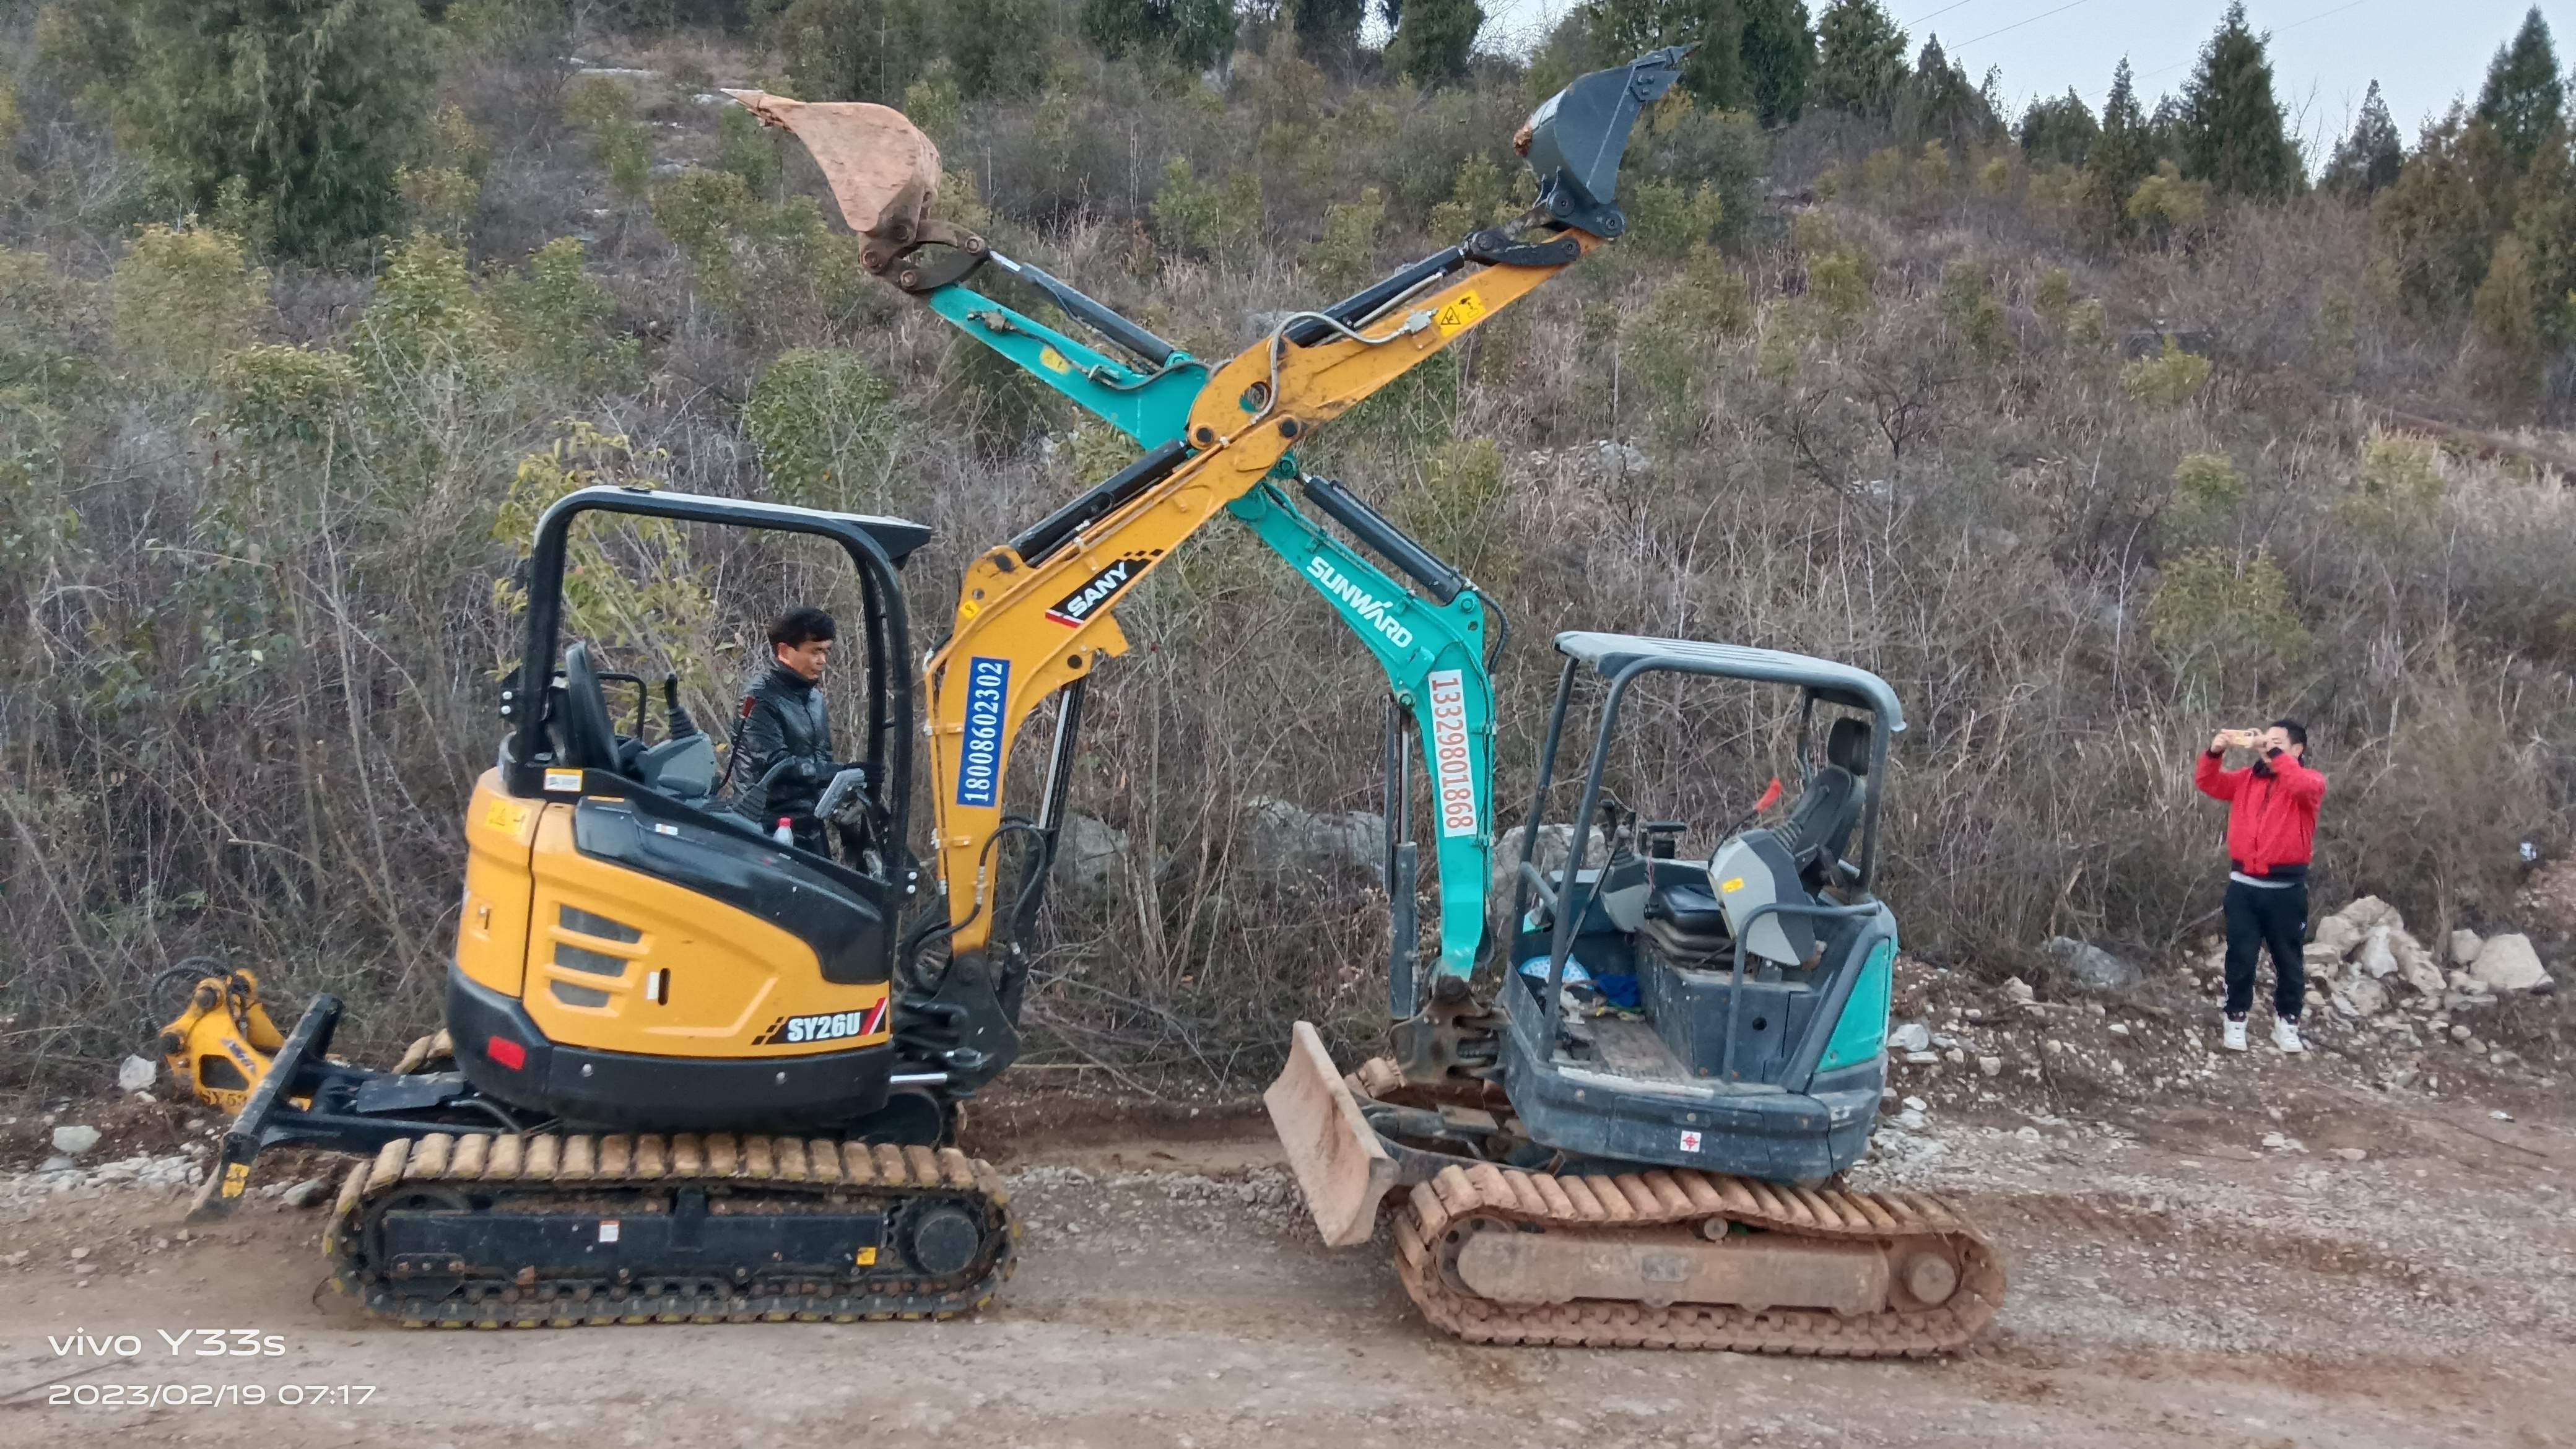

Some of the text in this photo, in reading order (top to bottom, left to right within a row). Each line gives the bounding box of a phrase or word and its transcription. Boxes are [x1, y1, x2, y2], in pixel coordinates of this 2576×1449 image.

[1067, 561, 1129, 617] SANY
[1307, 556, 1413, 648] SUNWARD
[964, 662, 1003, 802] 18008602302
[1432, 677, 1474, 829] 13329801868
[786, 1011, 861, 1042] SY26U
